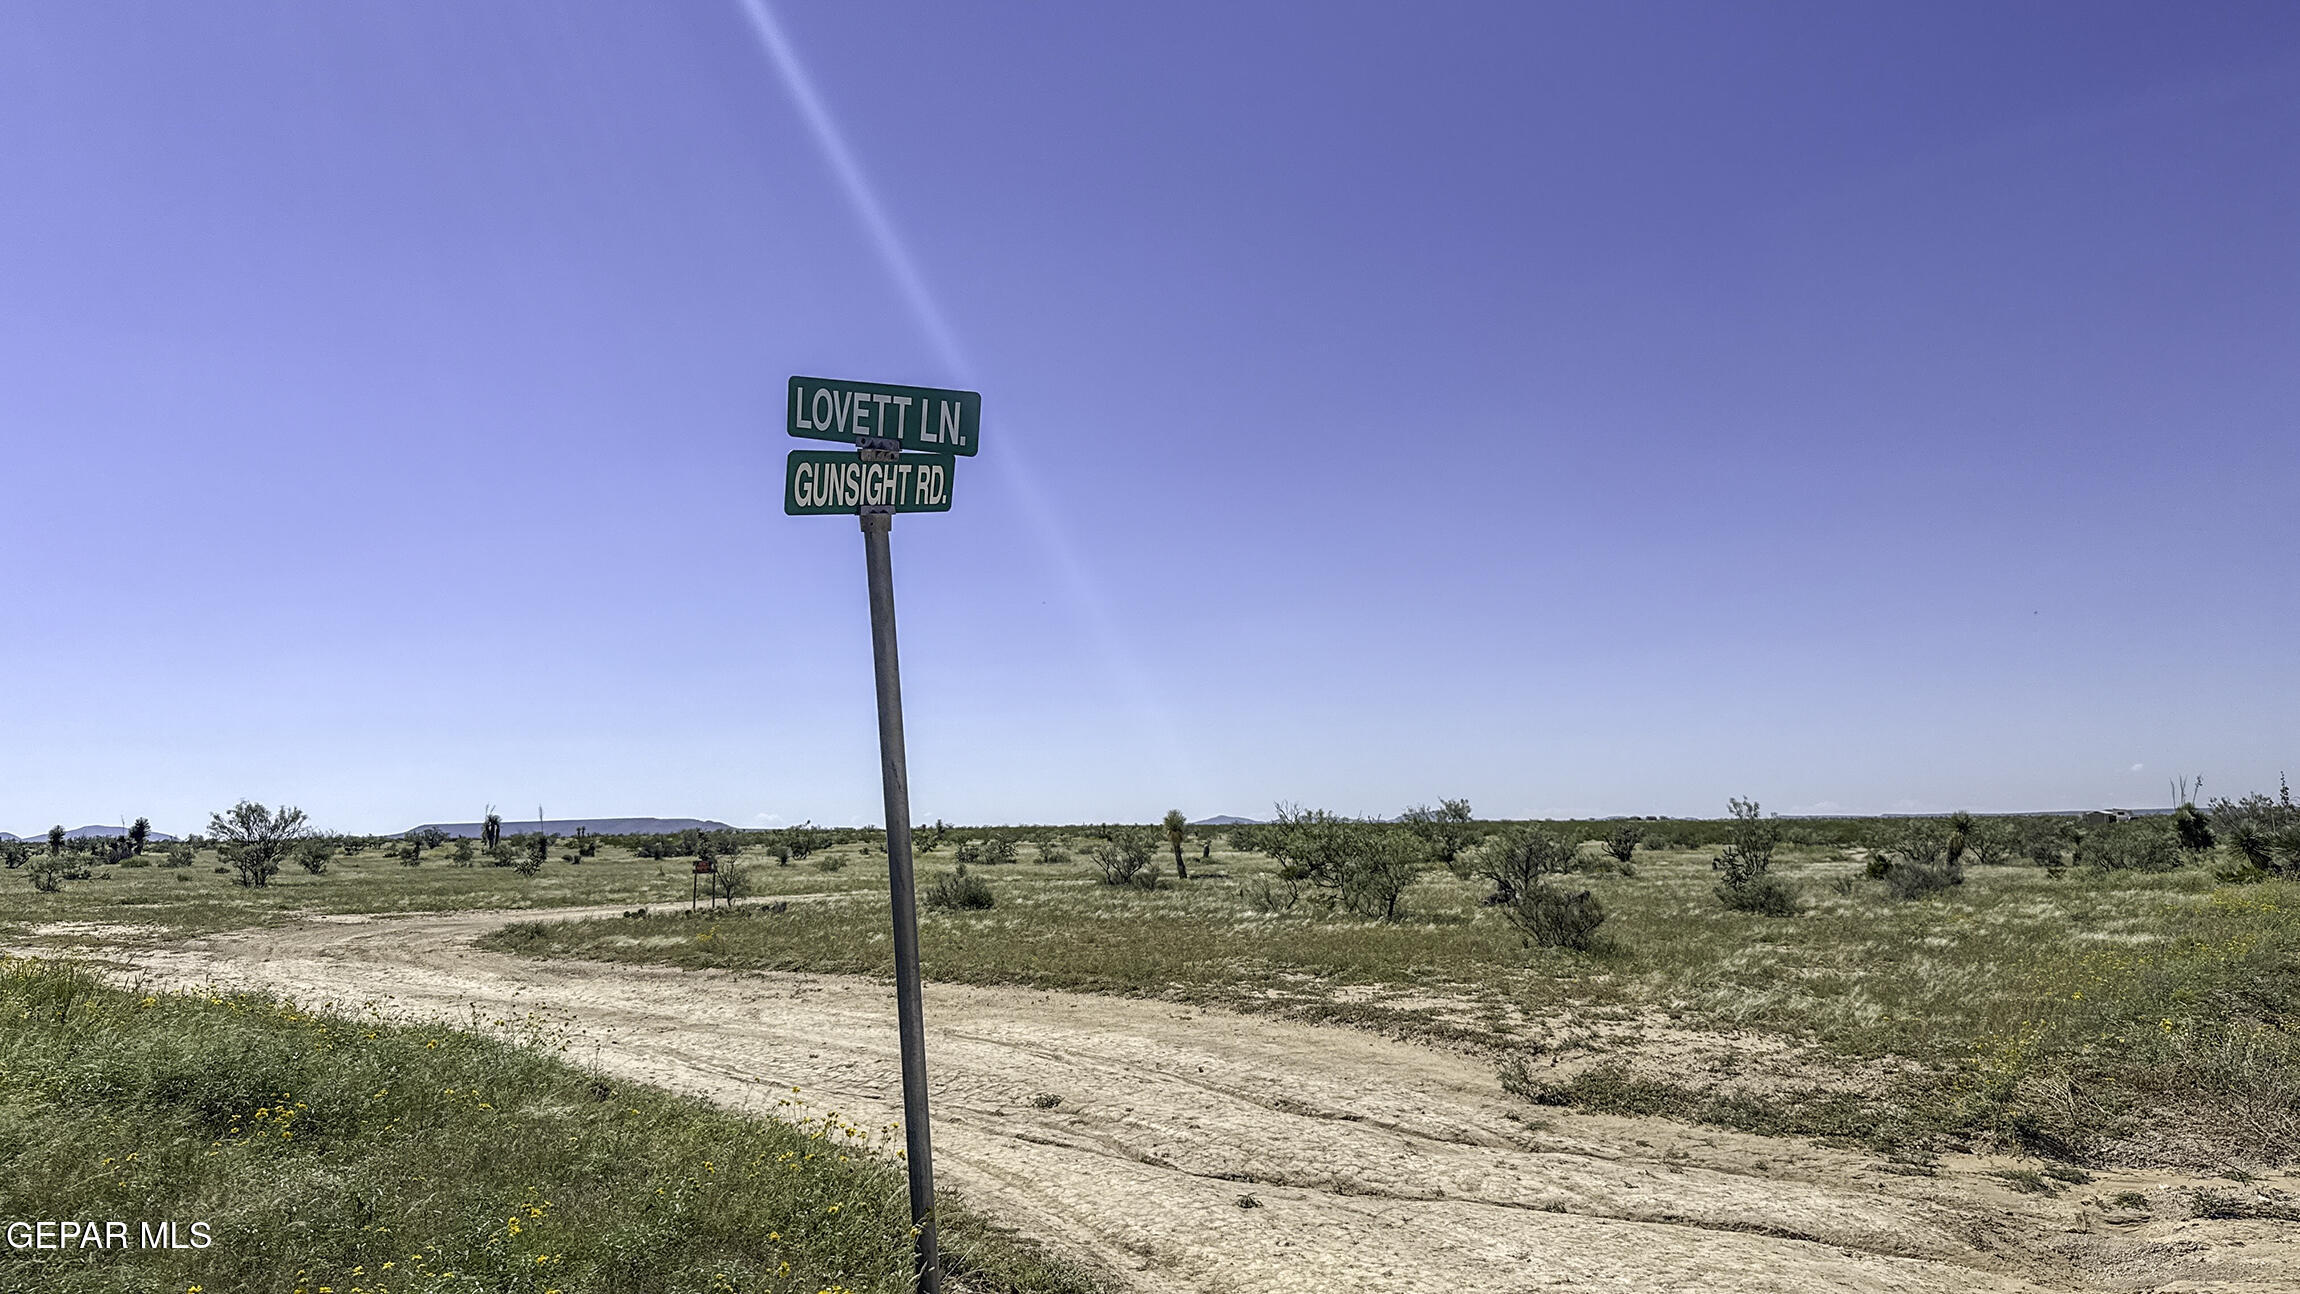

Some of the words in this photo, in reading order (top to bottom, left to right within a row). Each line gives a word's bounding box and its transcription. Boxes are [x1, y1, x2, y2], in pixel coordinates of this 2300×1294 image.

[796, 386, 912, 439] LOVETT
[920, 398, 966, 446] LN.
[794, 462, 912, 507] GUNSIGHT
[915, 464, 947, 505] RD.
